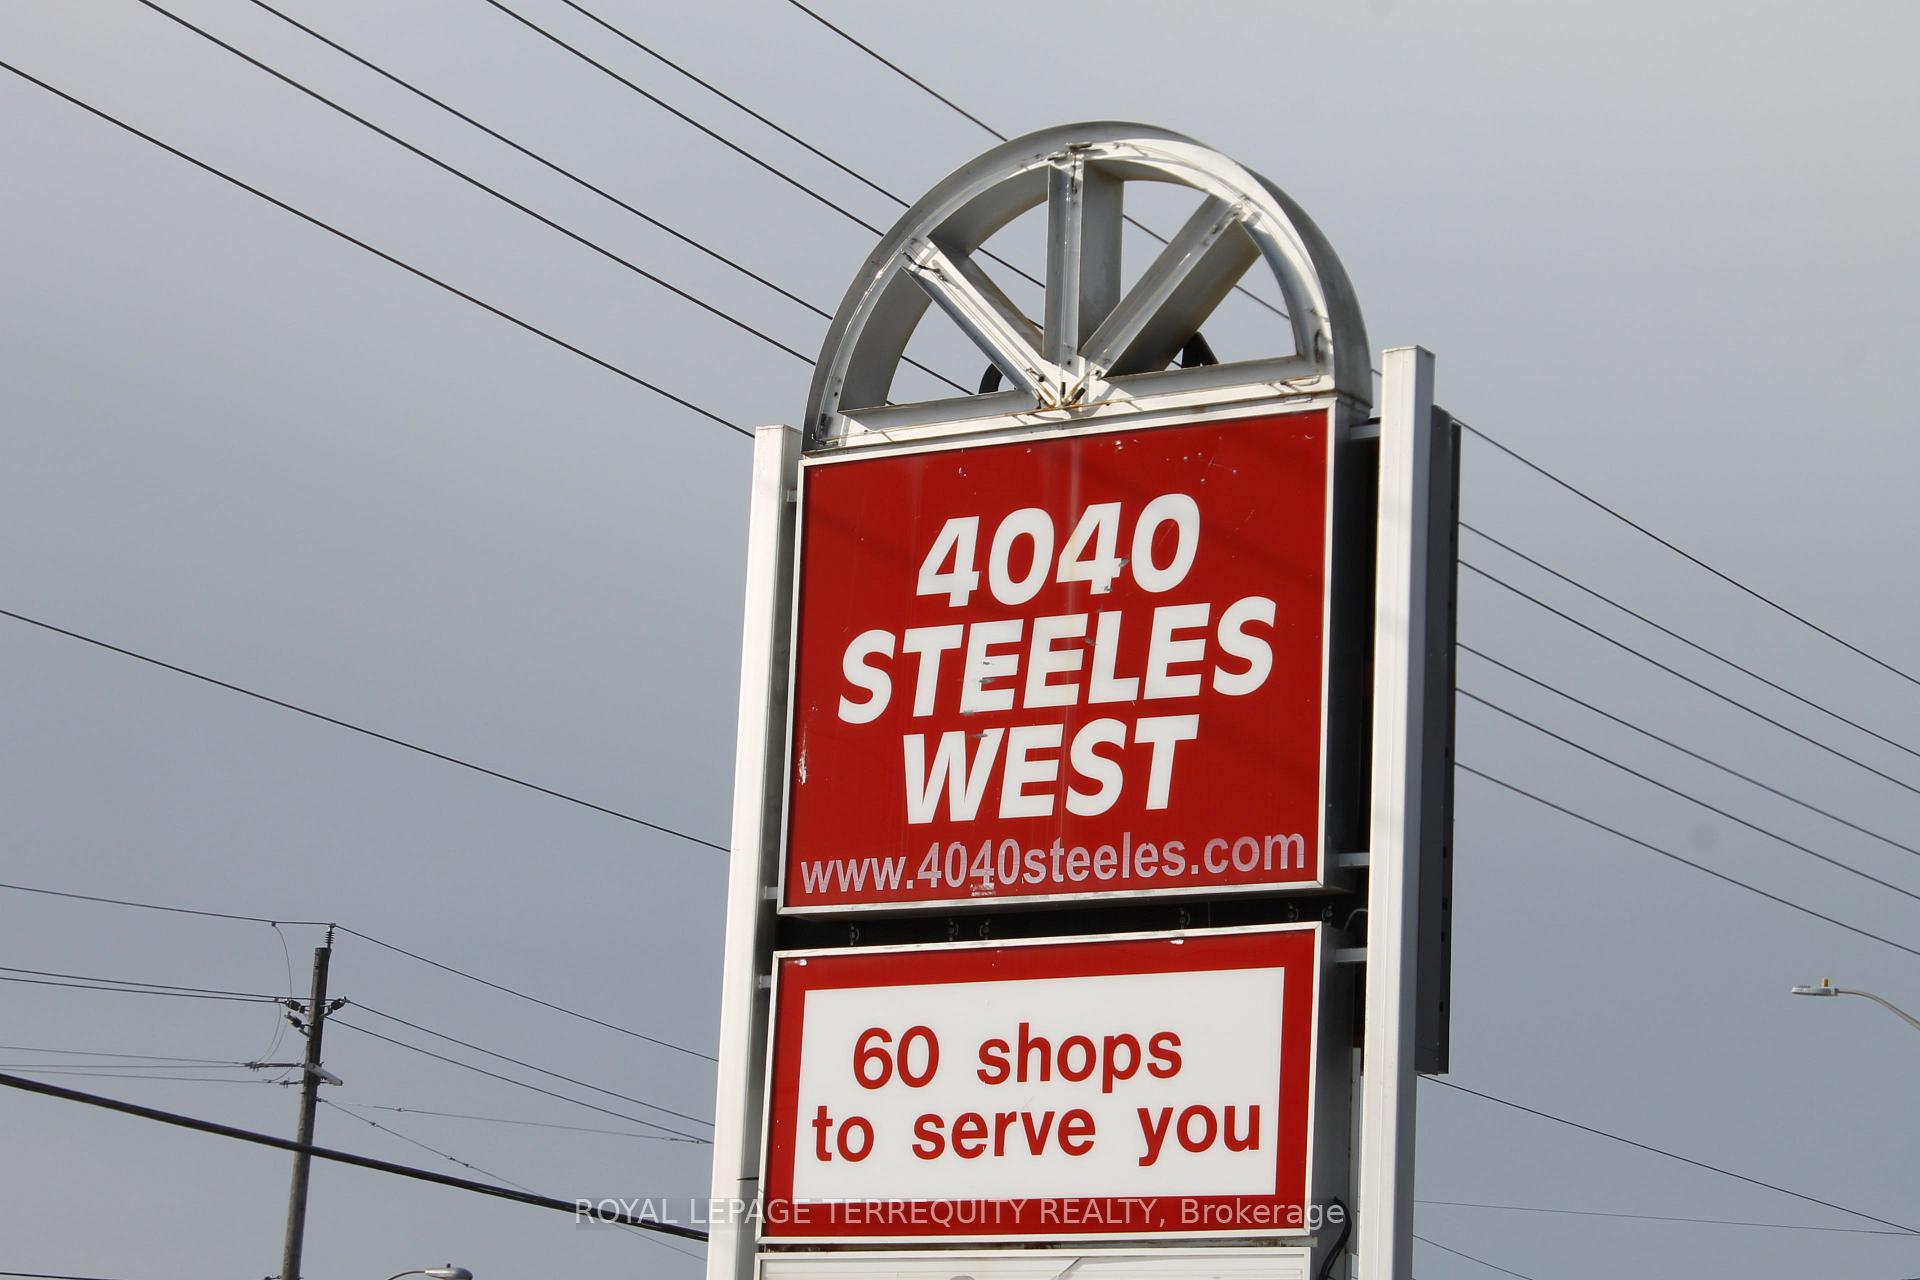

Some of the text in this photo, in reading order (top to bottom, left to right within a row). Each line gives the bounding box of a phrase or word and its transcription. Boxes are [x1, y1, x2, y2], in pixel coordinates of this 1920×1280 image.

[916, 493, 1200, 608] 4040
[838, 596, 1277, 724] STEELES
[903, 714, 1200, 824] WEST
[800, 832, 1305, 894] www.4040steeles.com
[853, 1021, 1183, 1094] 60 shops
[811, 1104, 1261, 1167] to serve you
